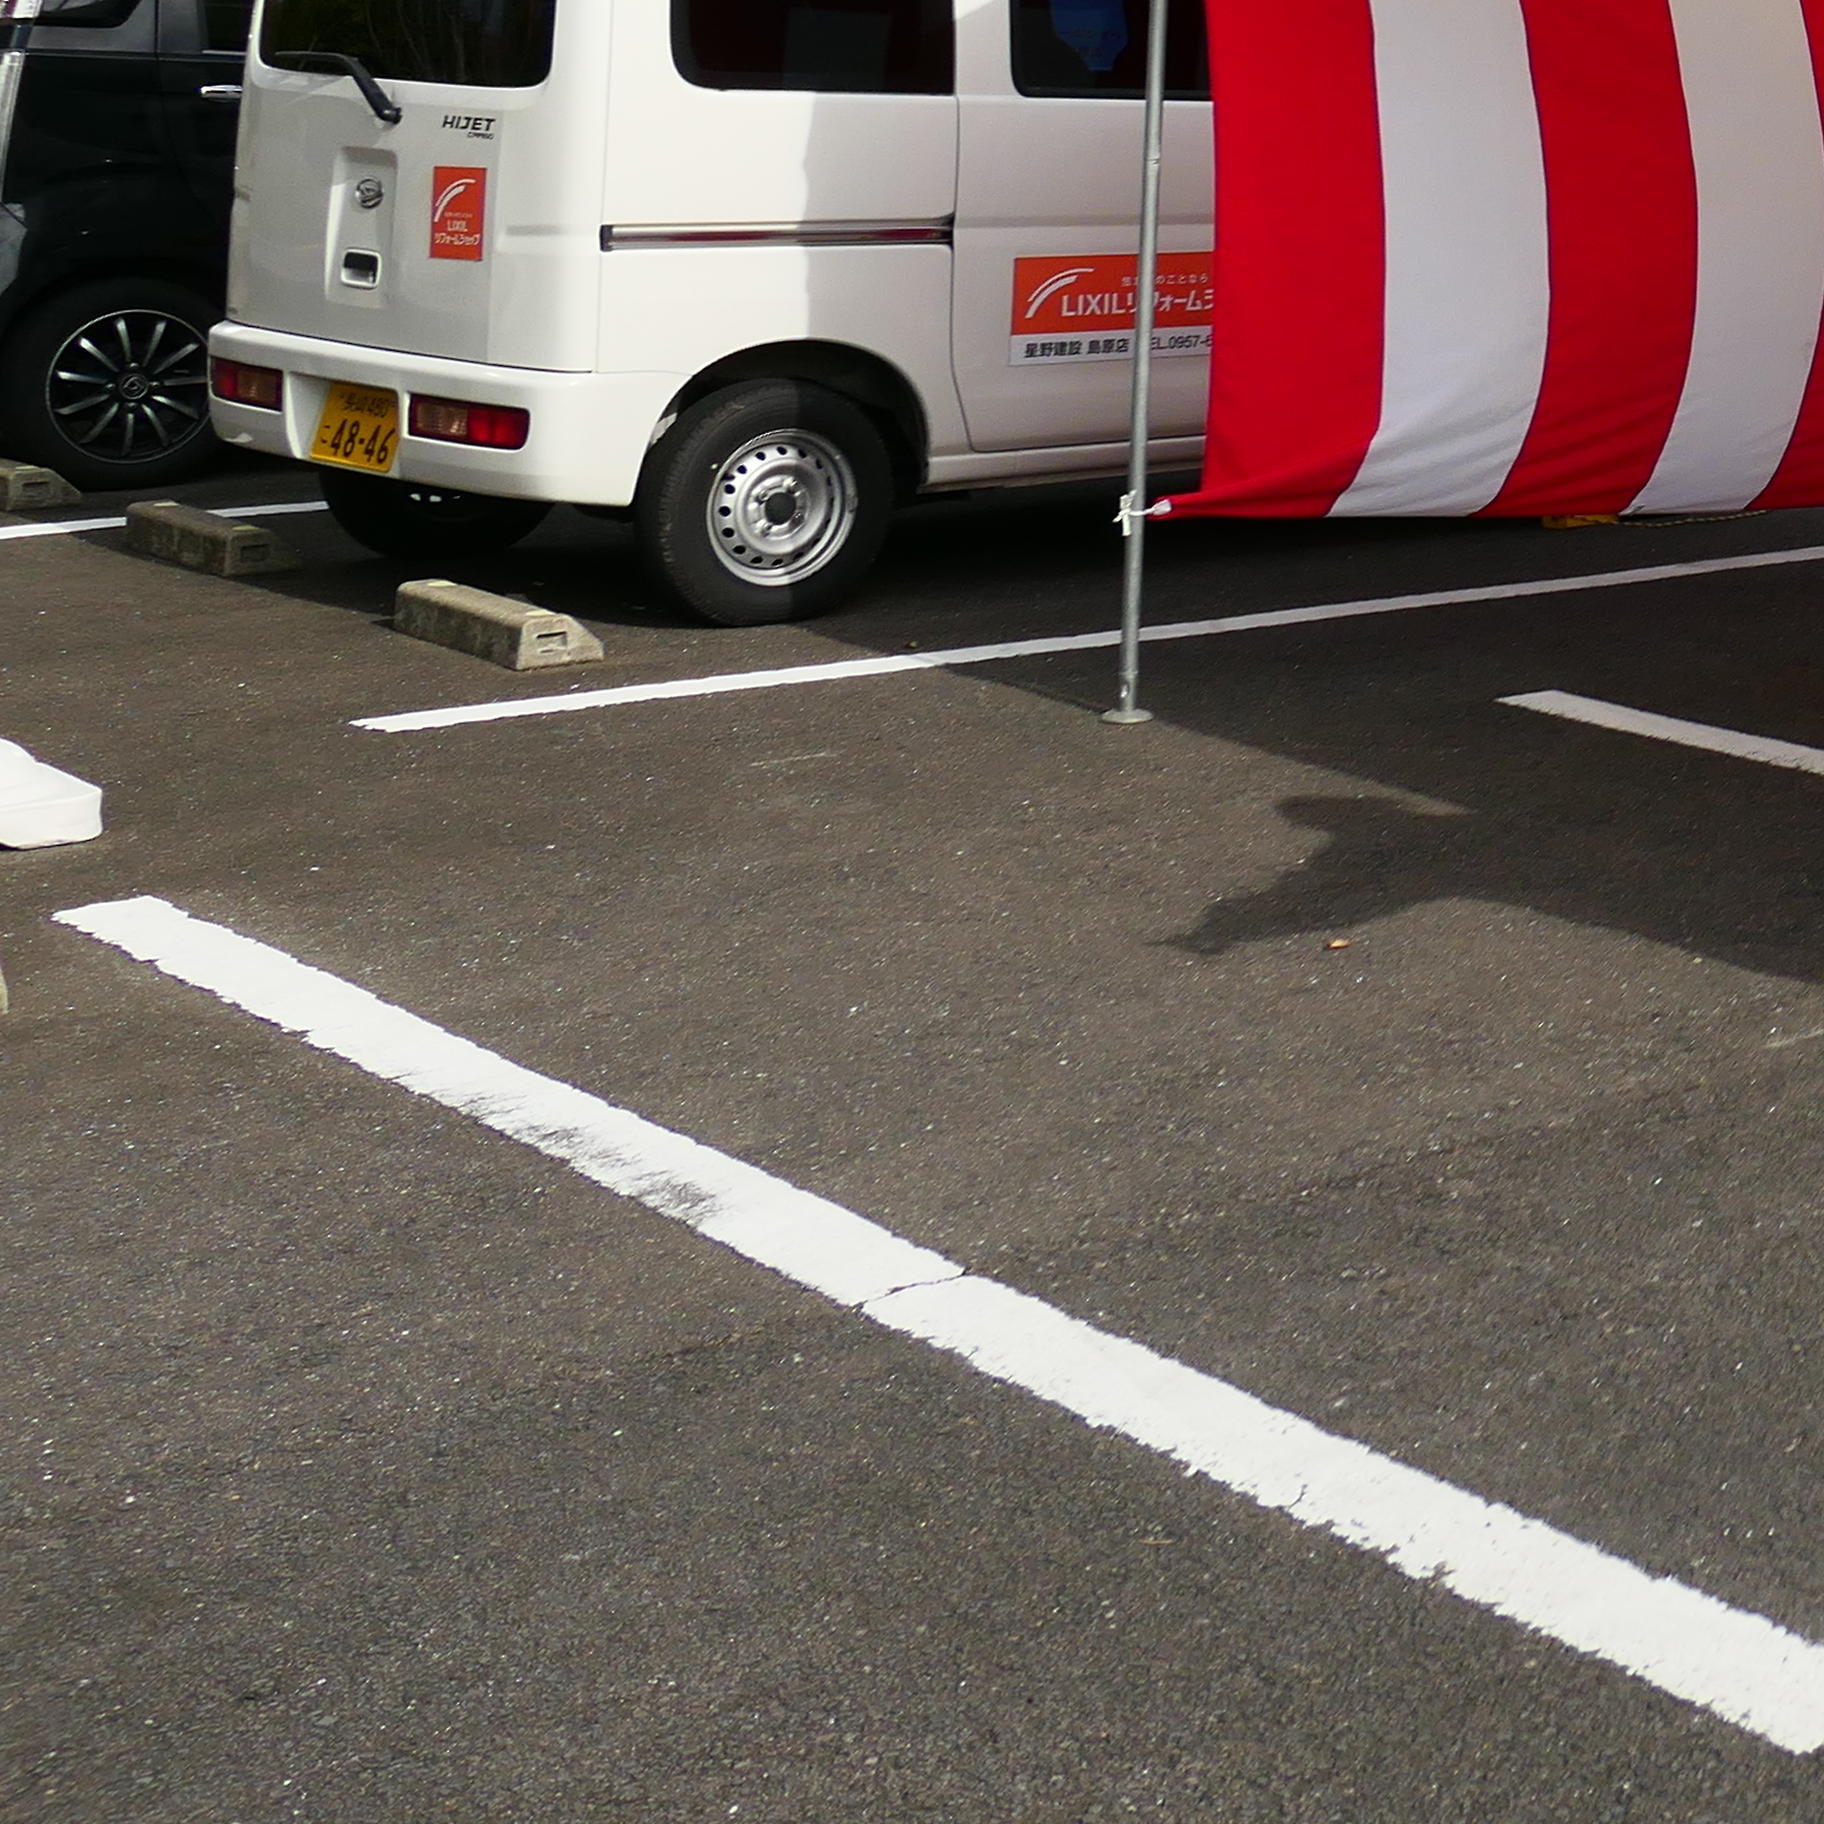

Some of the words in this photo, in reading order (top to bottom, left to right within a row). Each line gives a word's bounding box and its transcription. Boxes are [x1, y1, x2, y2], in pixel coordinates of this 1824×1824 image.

[442, 115, 496, 132] HIJET
[1061, 288, 1214, 317] LIXILリォームシ
